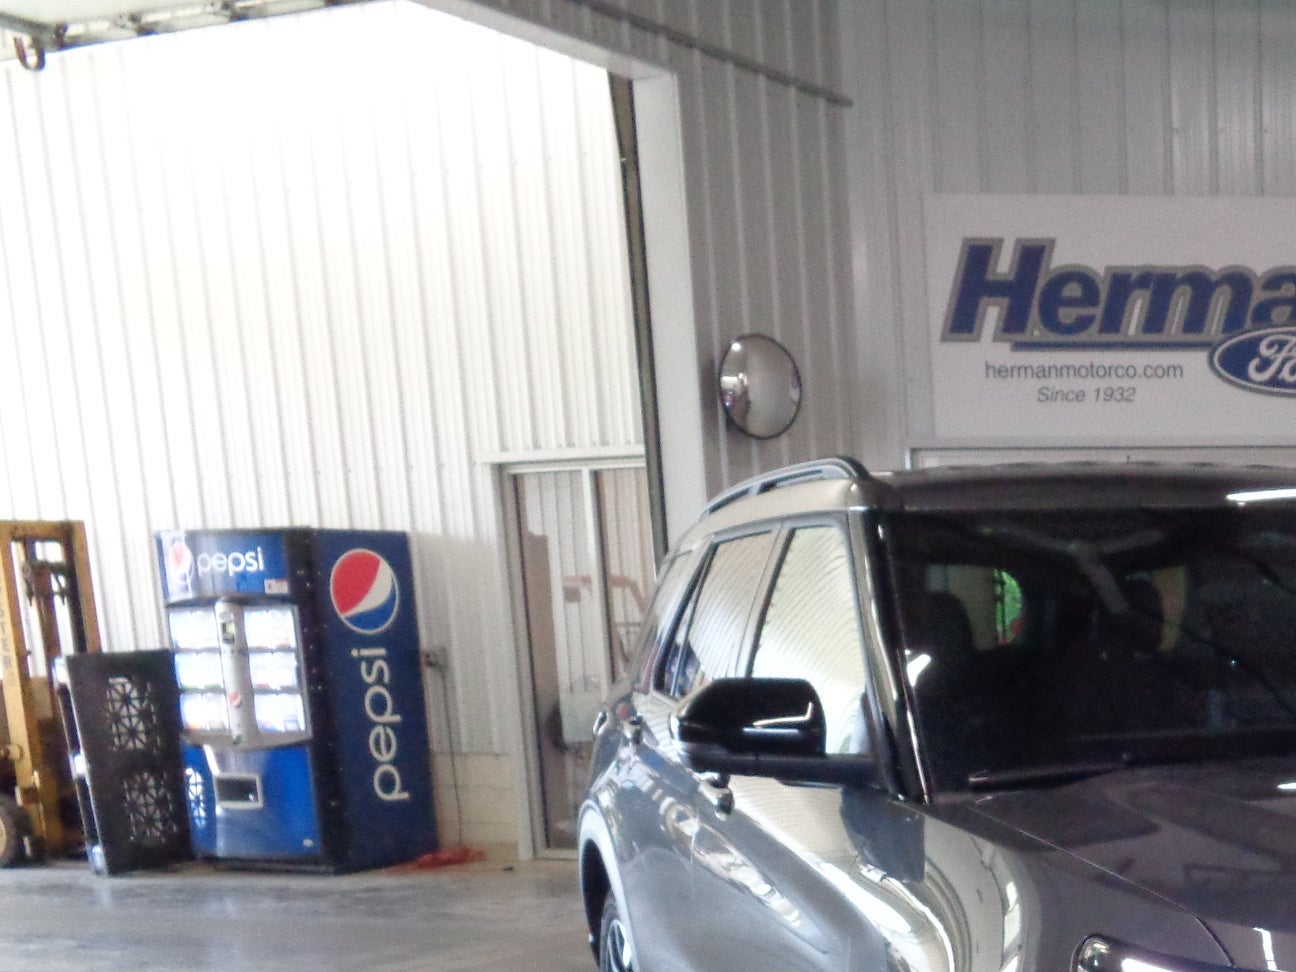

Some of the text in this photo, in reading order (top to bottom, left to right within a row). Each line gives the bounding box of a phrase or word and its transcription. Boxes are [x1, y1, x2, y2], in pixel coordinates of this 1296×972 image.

[985, 361, 1183, 380] hermanmotorco.com
[1037, 386, 1136, 403] Since 1932
[197, 546, 265, 577] pepsi
[350, 647, 410, 801] pepsi
